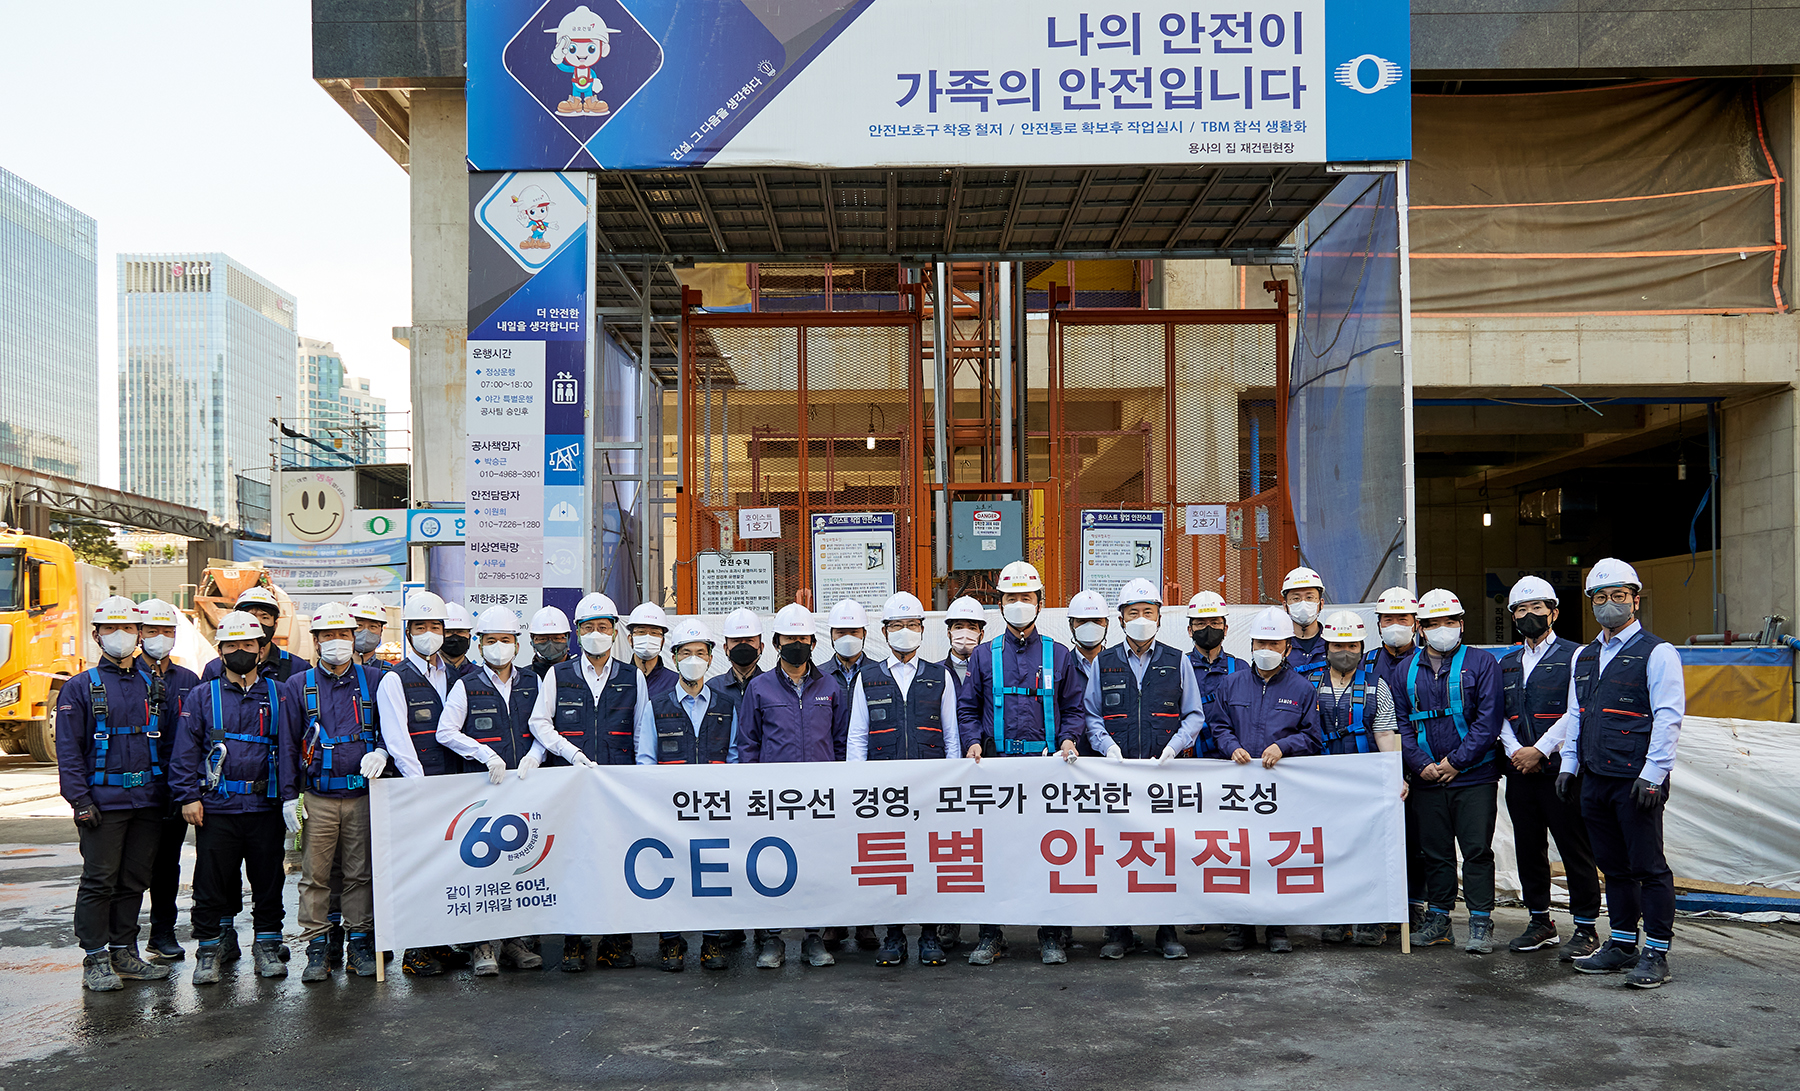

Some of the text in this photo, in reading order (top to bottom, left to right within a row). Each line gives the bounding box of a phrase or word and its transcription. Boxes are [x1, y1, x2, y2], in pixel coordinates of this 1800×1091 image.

[1046, 10, 1305, 57] 나의 안전이
[894, 65, 1308, 114] 가족의 안전입니다
[670, 76, 763, 161] 건설, 그 다음을 생각하다
[868, 120, 1308, 138] 안전보호구 착용 철저 / 안전통로 확보후 작업실시 / TBM 참석 생활화
[1188, 142, 1295, 154] 용사의 집 재건립현장
[536, 308, 580, 319] 더 안전한
[497, 321, 580, 332] 내일을 생각합니다
[472, 348, 512, 359] 운행시간
[485, 367, 516, 377] 정상운행
[480, 380, 533, 389] 07:00~18:00
[485, 394, 534, 404] 야간 특별운행
[480, 407, 529, 416] 공사팀 승인후
[472, 441, 520, 451] 공사책임자
[484, 457, 507, 466] 박승근
[471, 490, 520, 501] 안전담당자
[745, 513, 773, 521] 호이스트
[1097, 513, 1118, 521] 호이스트
[1131, 513, 1152, 521] 안전수칙
[746, 521, 772, 532] 1호기
[1192, 518, 1218, 529] 2호기
[470, 542, 519, 553] 비상연락망
[483, 558, 506, 568] 사무실
[560, 556, 571, 565] 24
[719, 559, 750, 567] 안전수칙
[478, 572, 541, 580] 02-796-5102~3
[297, 579, 321, 587] 생명을
[470, 594, 528, 605] 제한하중기준
[672, 781, 1279, 822] 안전 최우선 경영, 모두가 안전한 일터 조성
[507, 827, 539, 862] 한국자산관리공사
[624, 826, 1326, 900] CEO 특별 안전점검
[446, 877, 550, 900] 같이 키워온 60년,
[447, 894, 557, 917] 가치 키워갈 100년!
